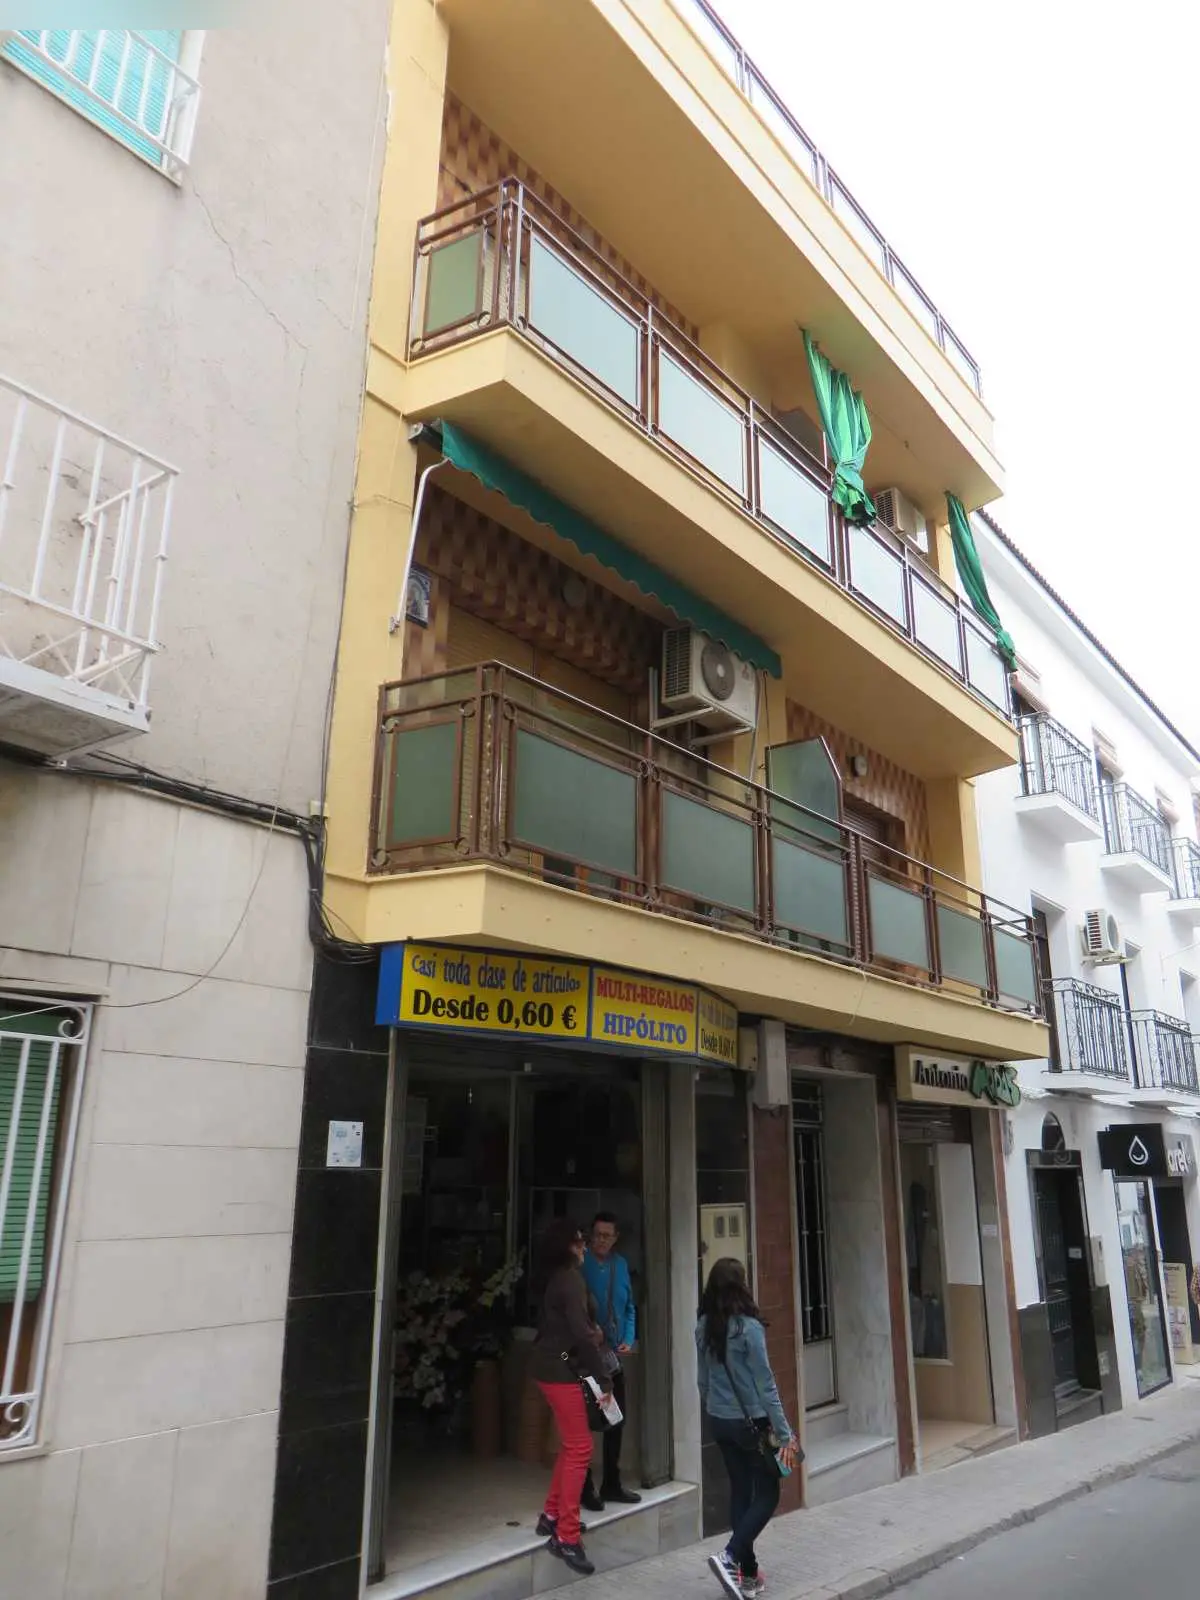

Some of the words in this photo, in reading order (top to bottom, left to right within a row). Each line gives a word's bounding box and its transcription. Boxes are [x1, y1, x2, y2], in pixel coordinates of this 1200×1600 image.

[411, 953, 437, 978] Casi
[443, 954, 471, 986] toda
[478, 953, 506, 990] clase
[513, 960, 527, 993] de
[533, 967, 581, 994] artículos
[412, 989, 489, 1022] Desde
[497, 998, 554, 1029] 0,60
[562, 1005, 577, 1030] €
[597, 976, 694, 1013] MULTI-REGALOS
[603, 1012, 687, 1045] HIPÓLITO
[914, 1059, 968, 1091] Antonio
